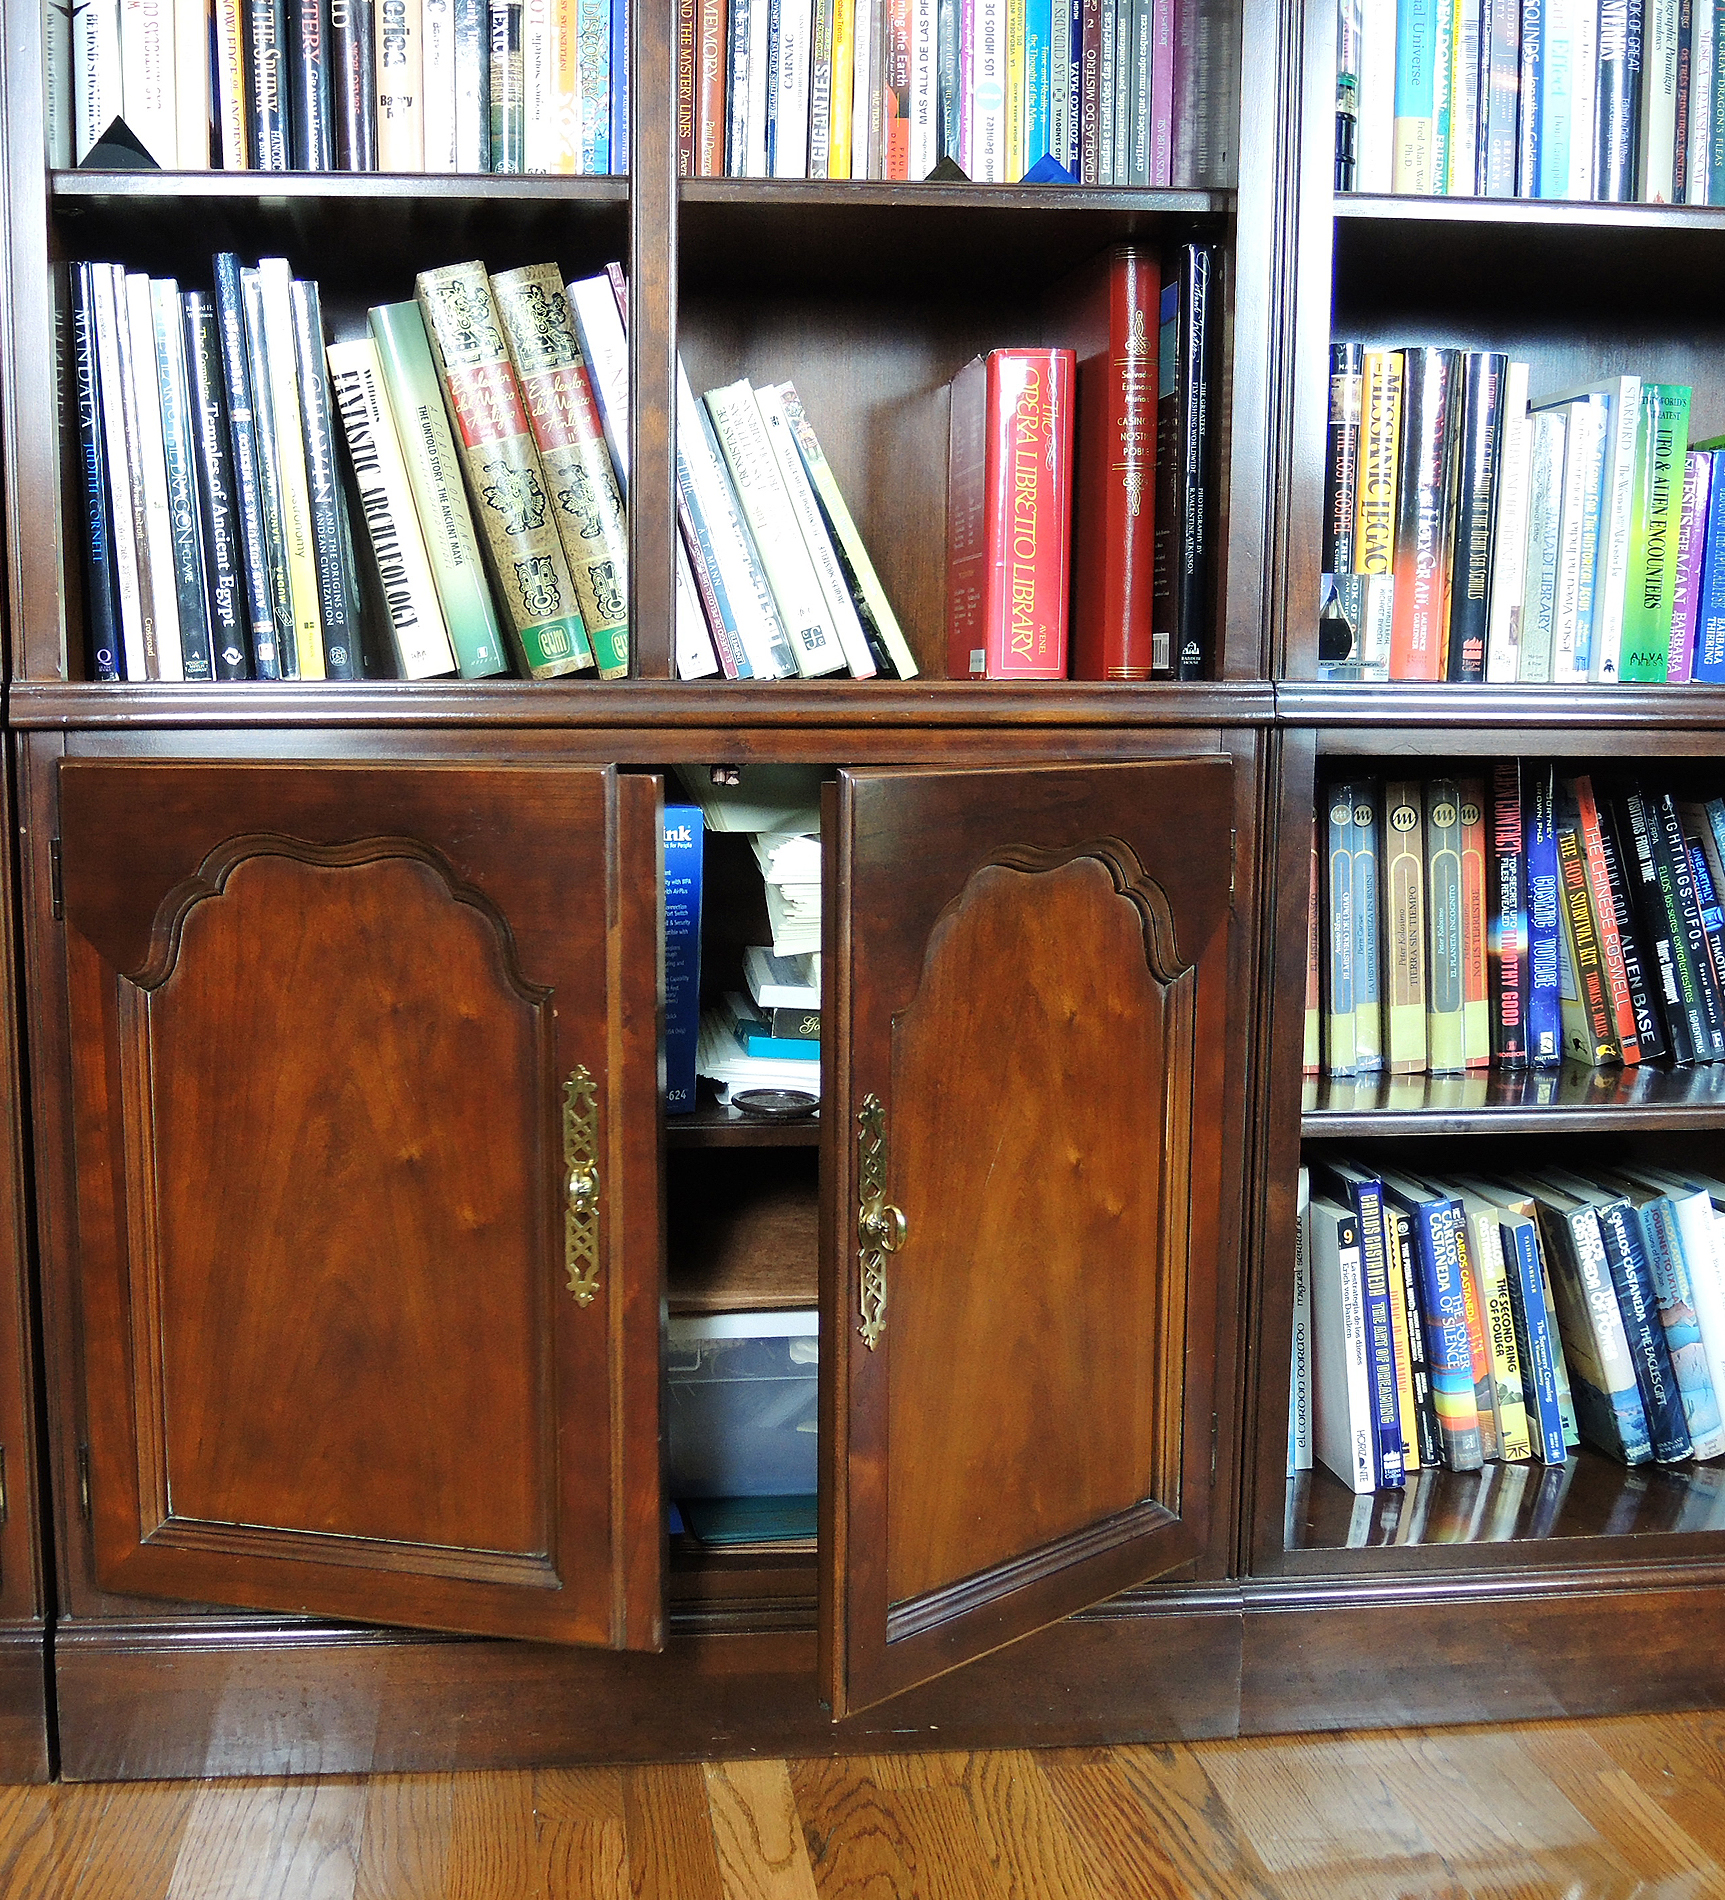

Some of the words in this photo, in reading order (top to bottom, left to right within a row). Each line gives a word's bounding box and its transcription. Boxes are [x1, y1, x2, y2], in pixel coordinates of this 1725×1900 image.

[86, 14, 99, 61] BEYOND
[252, 10, 276, 45] THE
[383, 1, 410, 67] erica
[897, 31, 908, 50] the
[920, 20, 929, 42] LAS
[1101, 12, 1112, 60] américas
[1118, 18, 1126, 65] condenados
[1140, 15, 1148, 55] esqueceu
[1655, 8, 1664, 51] paradoxes
[582, 2, 601, 103] DISCOVERY
[783, 34, 794, 89] CARNAC
[897, 55, 908, 87] Earth
[1028, 49, 1038, 78] Thought
[1102, 62, 1111, 79] das
[1411, 23, 1425, 86] Universe
[1551, 40, 1569, 96] Effect
[1664, 47, 1674, 95] Paradigm
[254, 49, 282, 113] SPHINX
[1071, 61, 1079, 92] MAYA
[1084, 50, 1096, 101] MISTÉRIO
[1118, 67, 1126, 90] povos
[1138, 58, 1146, 89] mundo
[1071, 96, 1079, 143] ZODIACO
[1086, 105, 1095, 120] DO
[1101, 81, 1112, 129] tradições
[1117, 92, 1126, 149] desaparecidos,
[1138, 98, 1147, 114] que
[1678, 89, 1686, 142] PRIMEIROS
[1135, 116, 1146, 171] civilizações
[1417, 121, 1425, 140] Fred
[1554, 115, 1564, 137] Don
[1071, 147, 1078, 160] EL
[1085, 124, 1095, 182] CIDADELAS
[1101, 139, 1111, 175] lendas
[1404, 144, 1413, 169] Ph.D.
[1416, 145, 1424, 166] Alan
[1492, 140, 1500, 189] GREENE
[1503, 140, 1511, 177] BRIAN
[1715, 138, 1723, 166] FLEAS
[418, 405, 429, 421] THE
[1015, 365, 1040, 444] OPERA
[1189, 382, 1198, 429] FLY-FISHING
[74, 309, 93, 428] MANDALA
[90, 499, 103, 564] CORNELL
[201, 403, 224, 477] Temples
[420, 423, 437, 455] UNTOLD
[1189, 432, 1197, 474] WORLDWIDE
[1336, 428, 1356, 454] THE
[1655, 429, 1673, 457] UFO
[427, 456, 443, 482] STORY
[1336, 456, 1353, 486] LOST
[1655, 461, 1671, 472] &
[210, 480, 227, 500] of
[332, 371, 382, 477] FANTASTIC
[369, 487, 419, 631] ARCHAEOLOGY
[1013, 451, 1037, 559] LIBRETTO
[1650, 475, 1670, 515] ALIEN
[316, 511, 330, 552] ANDEAN
[324, 511, 337, 533] AND
[438, 505, 456, 540] ANCIENT
[1333, 490, 1353, 535] GOSPEL
[210, 503, 231, 570] Ancient
[326, 536, 338, 559] THE
[447, 542, 463, 566] MAYA
[1186, 535, 1194, 574] ATKINSON
[1340, 537, 1348, 562] THE
[1580, 533, 1596, 584] HISTORICAL
[1643, 519, 1668, 610] ENCOUNTERS
[215, 575, 236, 627] Egypt
[318, 554, 335, 626] CIVILIZATION
[328, 563, 341, 607] ORIGINS
[1538, 571, 1552, 632] LIBRARY
[1561, 578, 1575, 615] Viveu
[1577, 586, 1593, 612] JESUS
[333, 610, 344, 625] OF
[1011, 562, 1036, 661] LIBRARY
[144, 619, 155, 657] Crossroad
[717, 629, 731, 652] JUEGO
[1038, 624, 1046, 655] AVENEL
[1412, 612, 1420, 650] GARDNER
[1419, 612, 1428, 651] LAURENCE
[1559, 619, 1573, 653] Jesus
[1671, 611, 1687, 672] BARBARA
[1703, 617, 1716, 665] THIERING
[1630, 652, 1663, 661] ALVA
[1585, 824, 1600, 856] THE
[1634, 836, 1652, 859] FROM
[1500, 858, 1509, 882] FILES
[1508, 857, 1518, 907] TOP-SECRET
[1563, 860, 1585, 890] HOPI
[1640, 860, 1655, 883] TIME
[1409, 886, 1417, 926] TIEMPO
[1501, 884, 1510, 927] REVEALED
[1590, 860, 1613, 929] CHINESE
[1398, 909, 1406, 945] Kolosimo
[1472, 890, 1480, 944] TERRESTRE
[1509, 909, 1518, 927] UFO
[1568, 891, 1593, 946] SURVIVAL
[1409, 929, 1417, 946] SIN
[1473, 946, 1480, 958] ES
[1398, 948, 1406, 966] Peter
[1409, 949, 1418, 986] TIERRA
[1450, 968, 1457, 977] EL
[1473, 961, 1481, 977] NO
[1500, 929, 1519, 986] TIMOTHY
[1533, 938, 1557, 989] VOYAGE
[1579, 947, 1598, 967] KIT
[1603, 934, 1629, 1012] ROSWELL
[1620, 934, 1643, 989] ALIEN
[1633, 993, 1655, 1044] BASE
[1501, 991, 1519, 1026] GOOD
[1360, 1193, 1382, 1235] CARLOS
[1429, 1212, 1450, 1292] CASTANEDA
[1442, 1210, 1457, 1265] CARLOS
[1455, 1231, 1468, 1267] CARLOS
[1363, 1236, 1386, 1297] CASTANEDA
[1611, 1211, 1630, 1256] CARLOS
[1621, 1256, 1647, 1323] CASTANEDA
[1639, 1324, 1652, 1348] THE
[1440, 1296, 1452, 1316] OF
[1453, 1292, 1465, 1321] THE
[1459, 1270, 1476, 1324] CASTANEDA
[1489, 1299, 1499, 1315] OF
[1497, 1278, 1507, 1299] THE
[1372, 1301, 1387, 1324] THE
[1500, 1300, 1513, 1344] SECOND
[1374, 1326, 1389, 1347] ART
[1442, 1318, 1459, 1369] SILENCE
[1457, 1322, 1470, 1370] POWER
[1493, 1316, 1504, 1357] POWER
[1376, 1349, 1390, 1363] OF
[1505, 1346, 1517, 1373] RING
[1376, 1364, 1395, 1424] DREAMING
